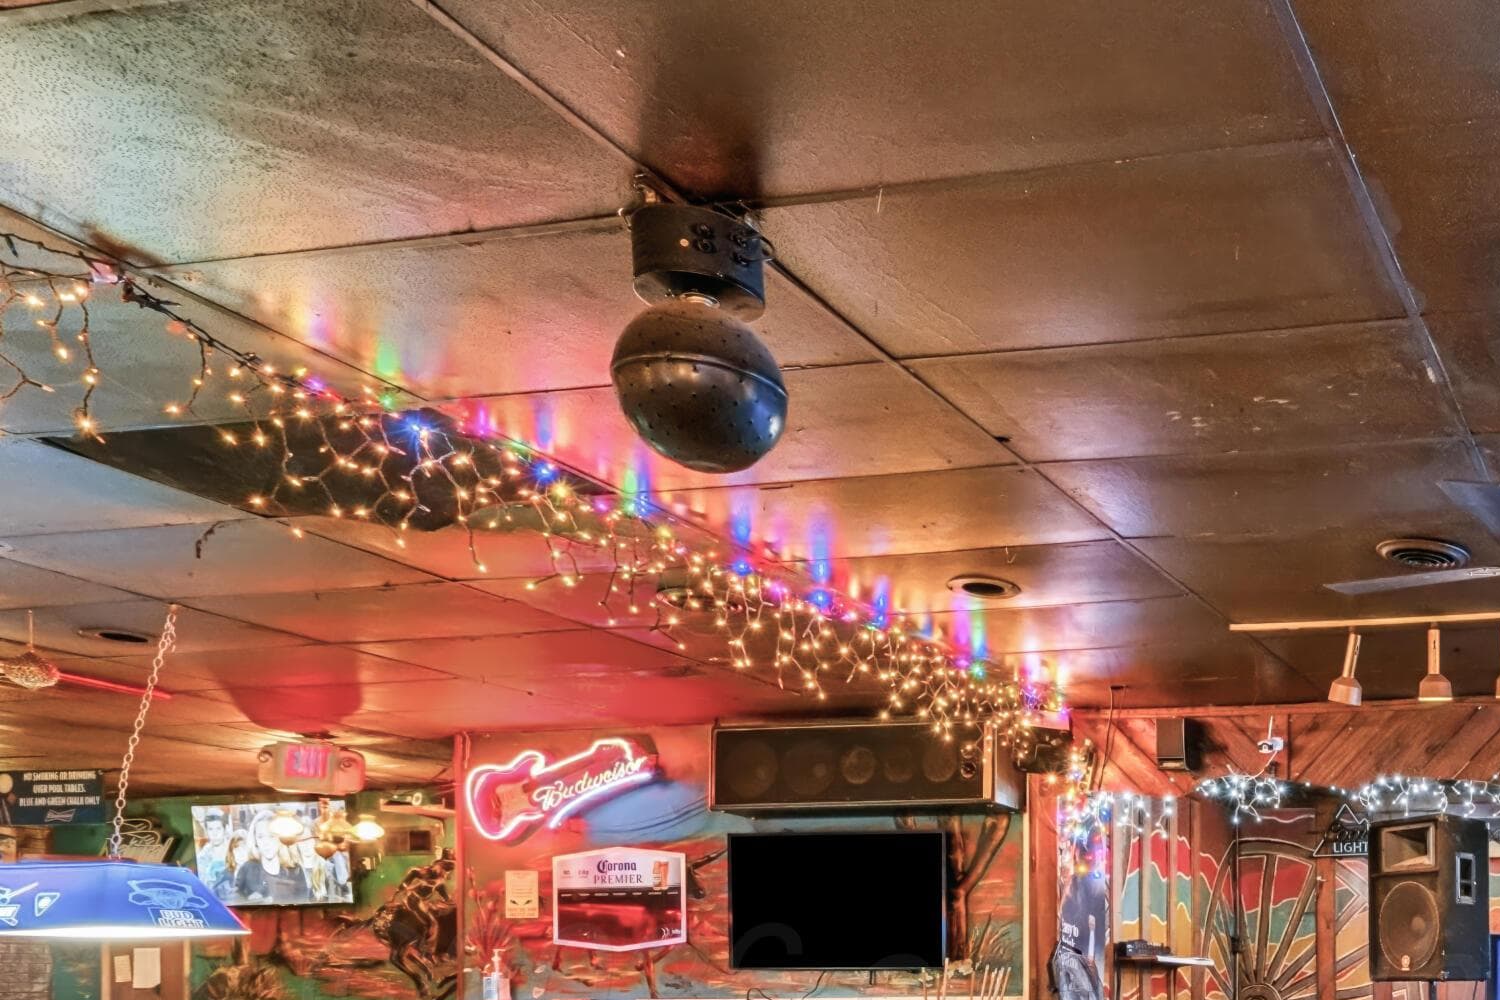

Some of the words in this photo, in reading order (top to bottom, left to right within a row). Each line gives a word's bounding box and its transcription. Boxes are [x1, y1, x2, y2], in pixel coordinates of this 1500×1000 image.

[23, 771, 32, 781] NO
[33, 771, 59, 781] SMOKING
[68, 770, 97, 780] DRINKING
[33, 784, 48, 793] OVER
[49, 784, 63, 793] POOL
[532, 756, 648, 811] Budweiser
[19, 797, 33, 807] BLUE
[34, 797, 46, 806] AND
[47, 796, 66, 806] GREEN
[67, 796, 84, 806] CHALK
[85, 795, 100, 805] ONLY
[597, 860, 637, 873] Corona
[593, 874, 643, 885] PREMIER
[160, 909, 194, 919] BUD
